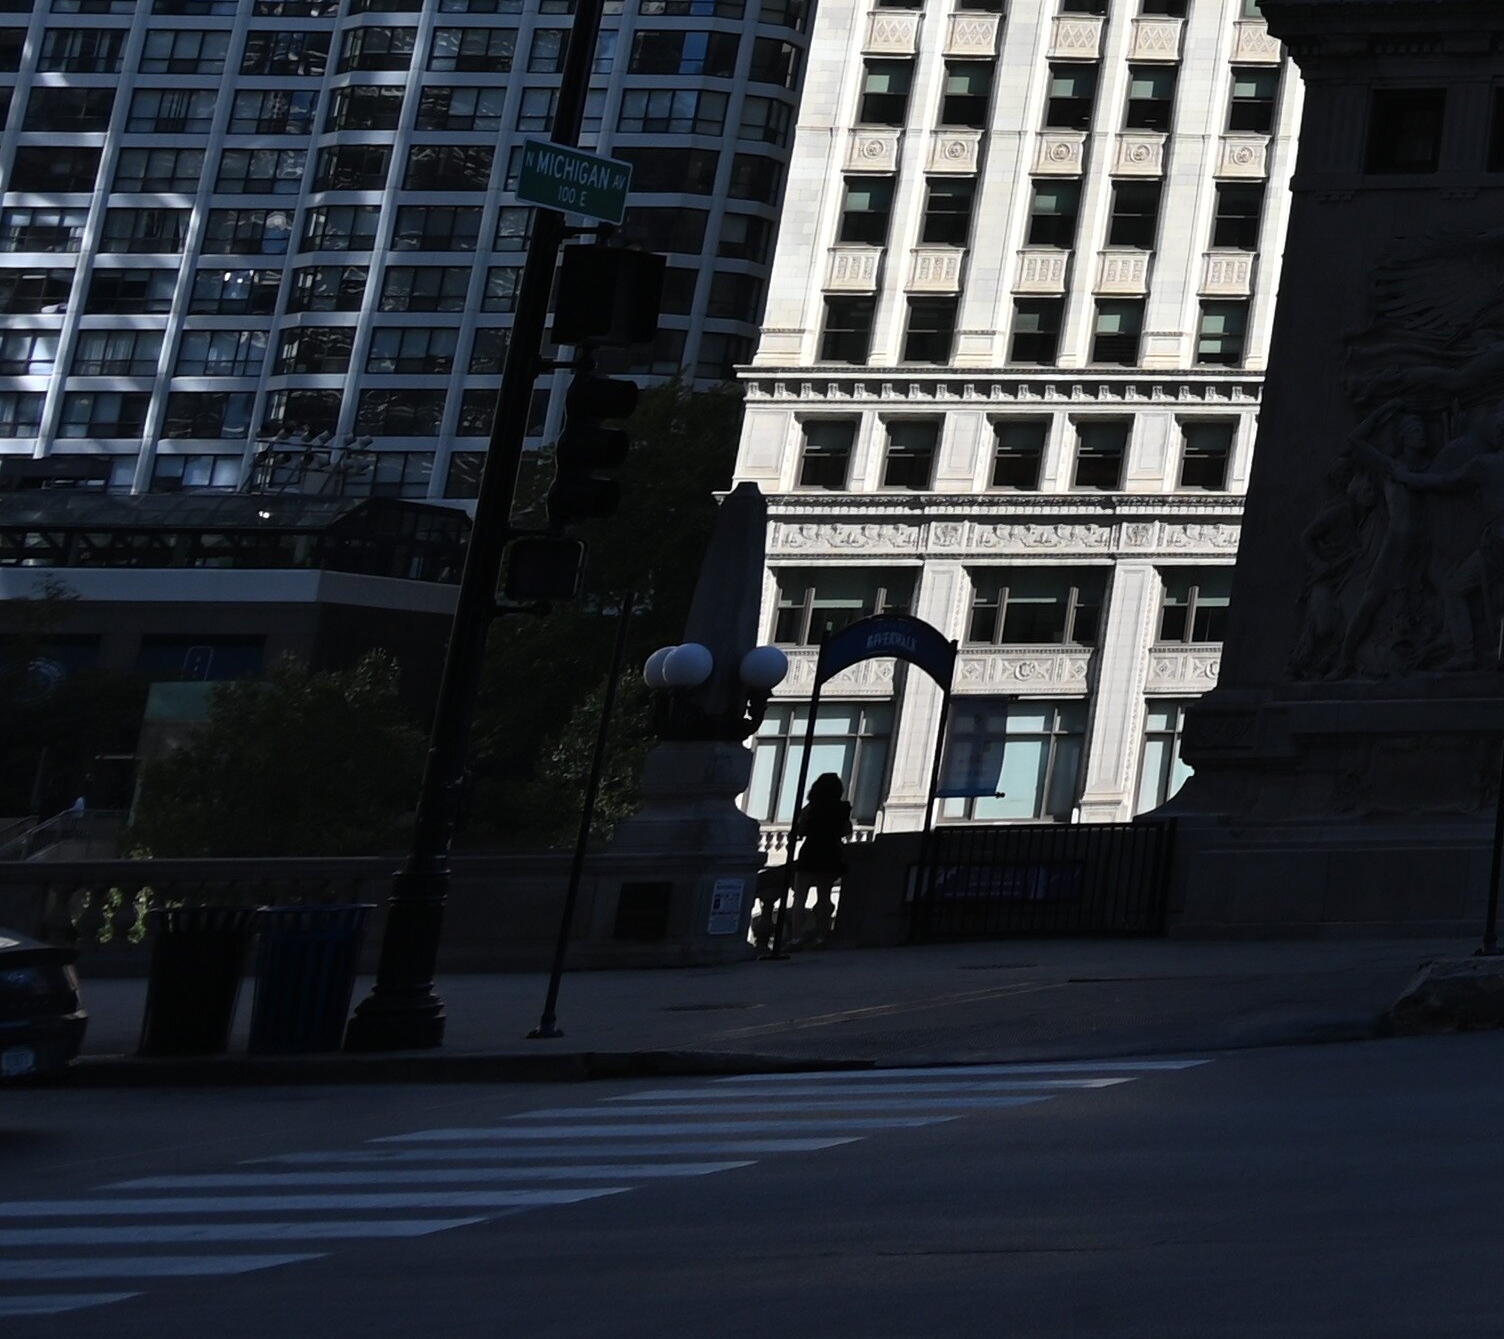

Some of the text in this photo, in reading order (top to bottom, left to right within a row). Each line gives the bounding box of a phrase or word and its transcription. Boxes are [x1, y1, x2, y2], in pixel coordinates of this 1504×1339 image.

[536, 150, 611, 191] MICHIGAN
[557, 186, 588, 207] 100 E
